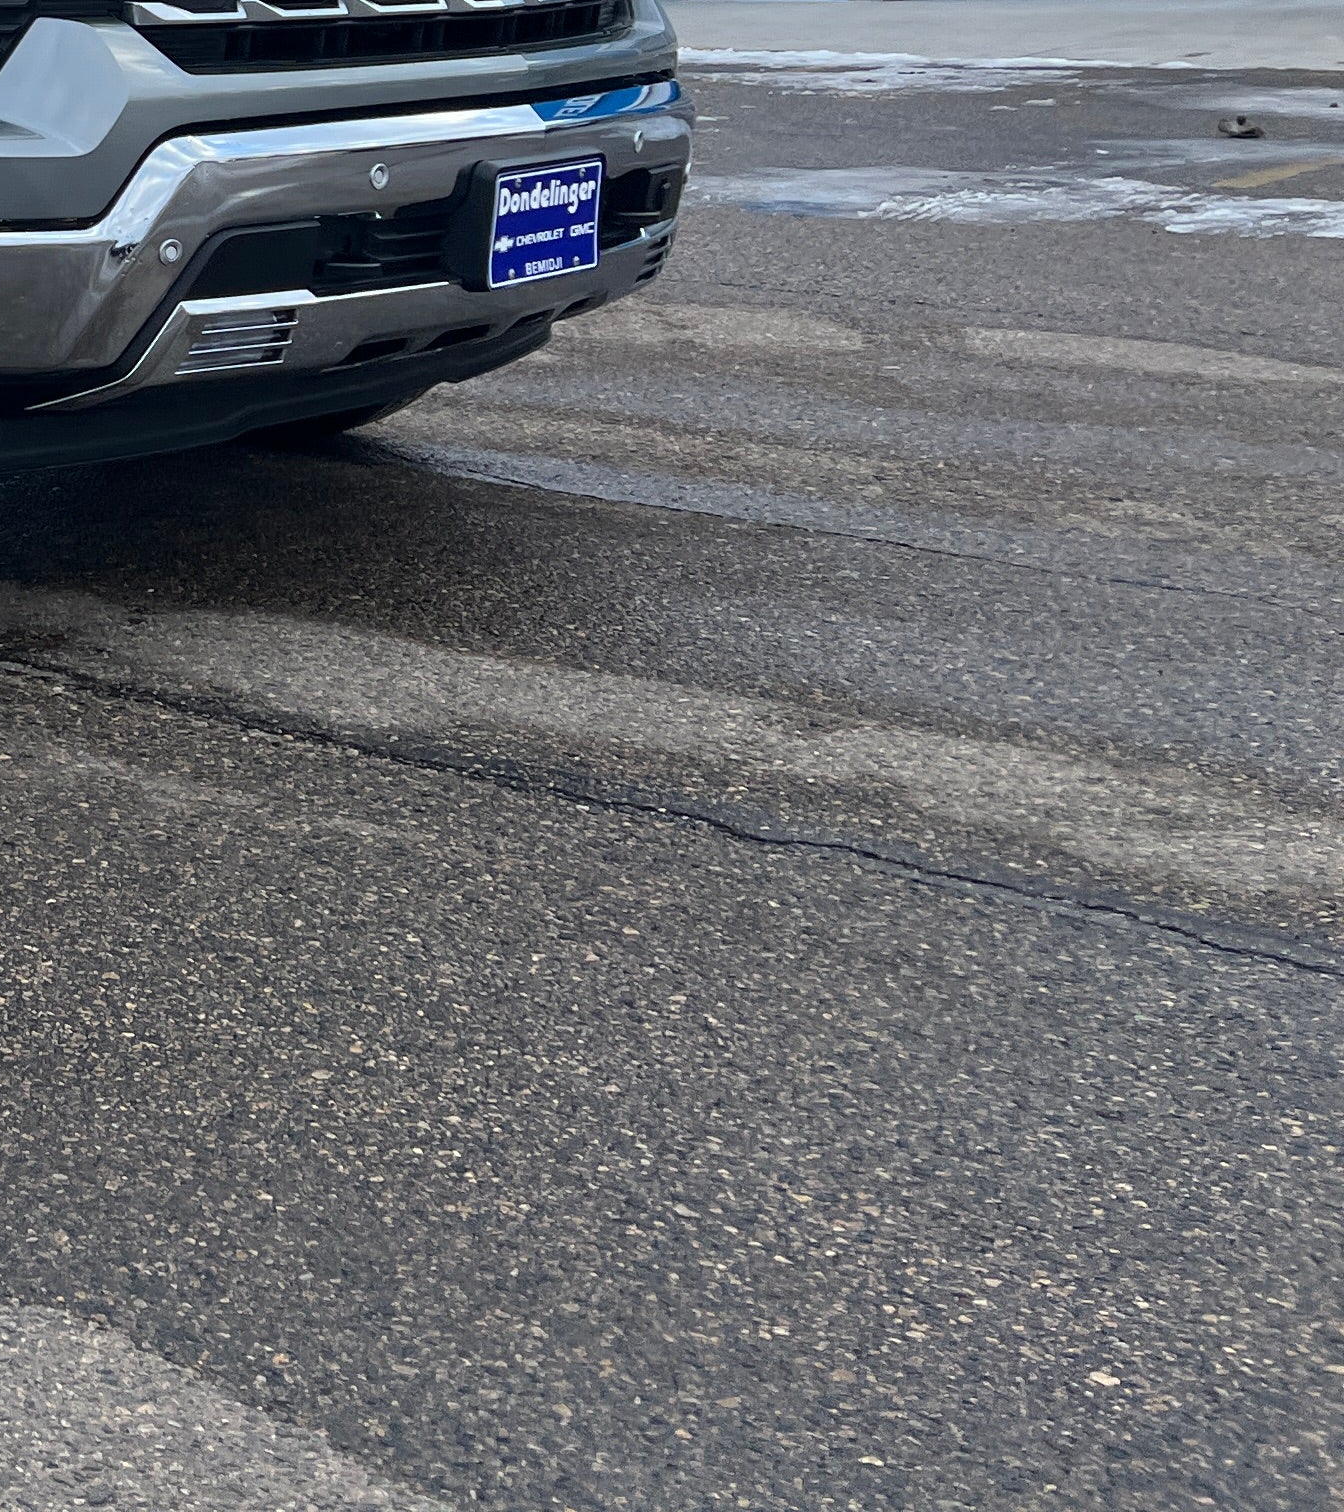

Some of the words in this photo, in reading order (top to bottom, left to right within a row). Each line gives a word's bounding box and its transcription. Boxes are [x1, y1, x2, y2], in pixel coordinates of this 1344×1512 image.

[498, 179, 597, 216] Dondelinger
[516, 228, 565, 247] CHEVROLET
[570, 221, 595, 238] GMC
[525, 257, 563, 276] BEMIDJI
